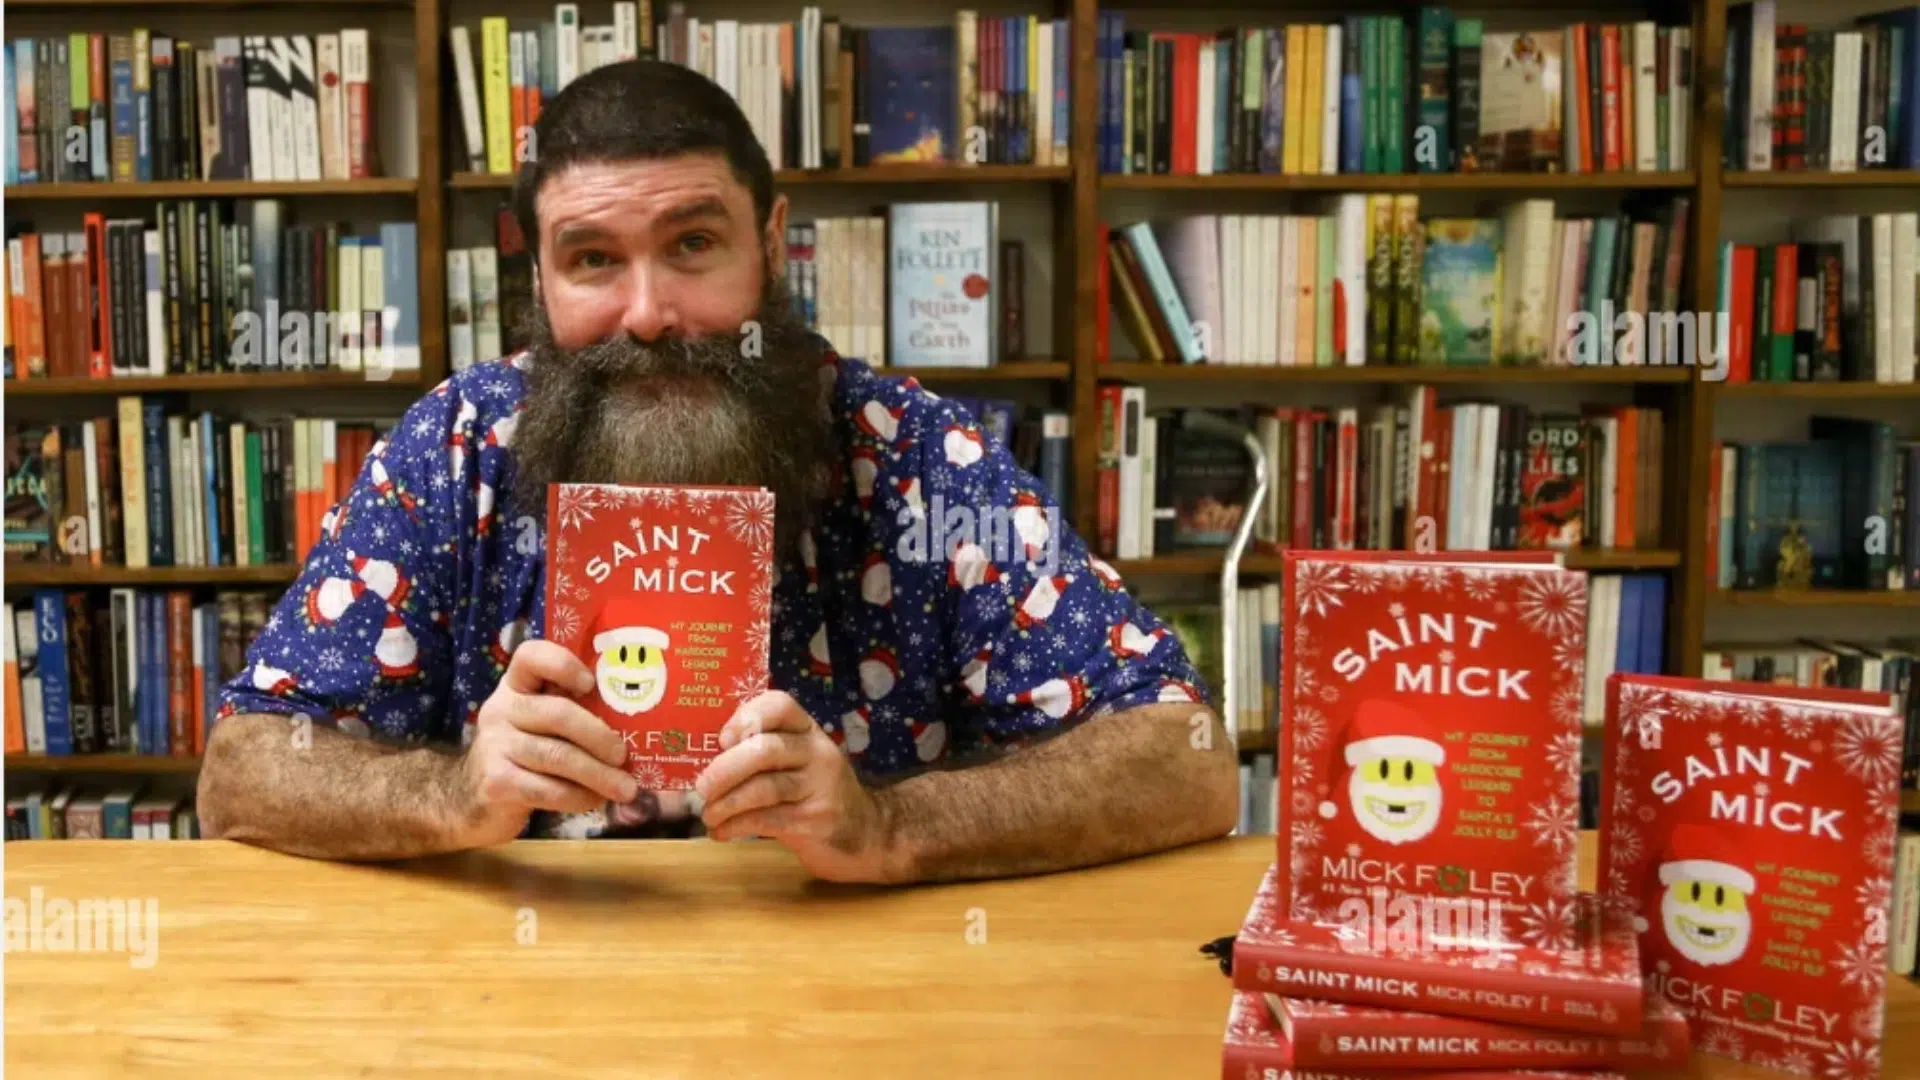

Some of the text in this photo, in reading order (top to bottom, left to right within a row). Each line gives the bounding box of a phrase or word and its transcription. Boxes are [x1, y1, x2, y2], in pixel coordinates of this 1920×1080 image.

[919, 229, 961, 247] KEN
[1528, 456, 1580, 475] LIES
[585, 516, 711, 584] SAINT
[633, 555, 735, 595] MICK
[688, 634, 716, 645] FROM
[1332, 602, 1497, 682] SAINT
[682, 659, 720, 669] LEGEND
[694, 671, 708, 682] TO
[1394, 650, 1531, 700] MICK
[645, 729, 719, 752] FOLE
[1651, 732, 1813, 803] SAINT
[1710, 782, 1845, 841] MICK
[1322, 843, 1535, 898] MICK FOLEY
[1275, 965, 1534, 1011] SAINT MICK MICK FOLEY
[1721, 987, 1841, 1035] FOLEY
[1337, 1035, 1591, 1056] SAINT MICK MICK FOLEY
